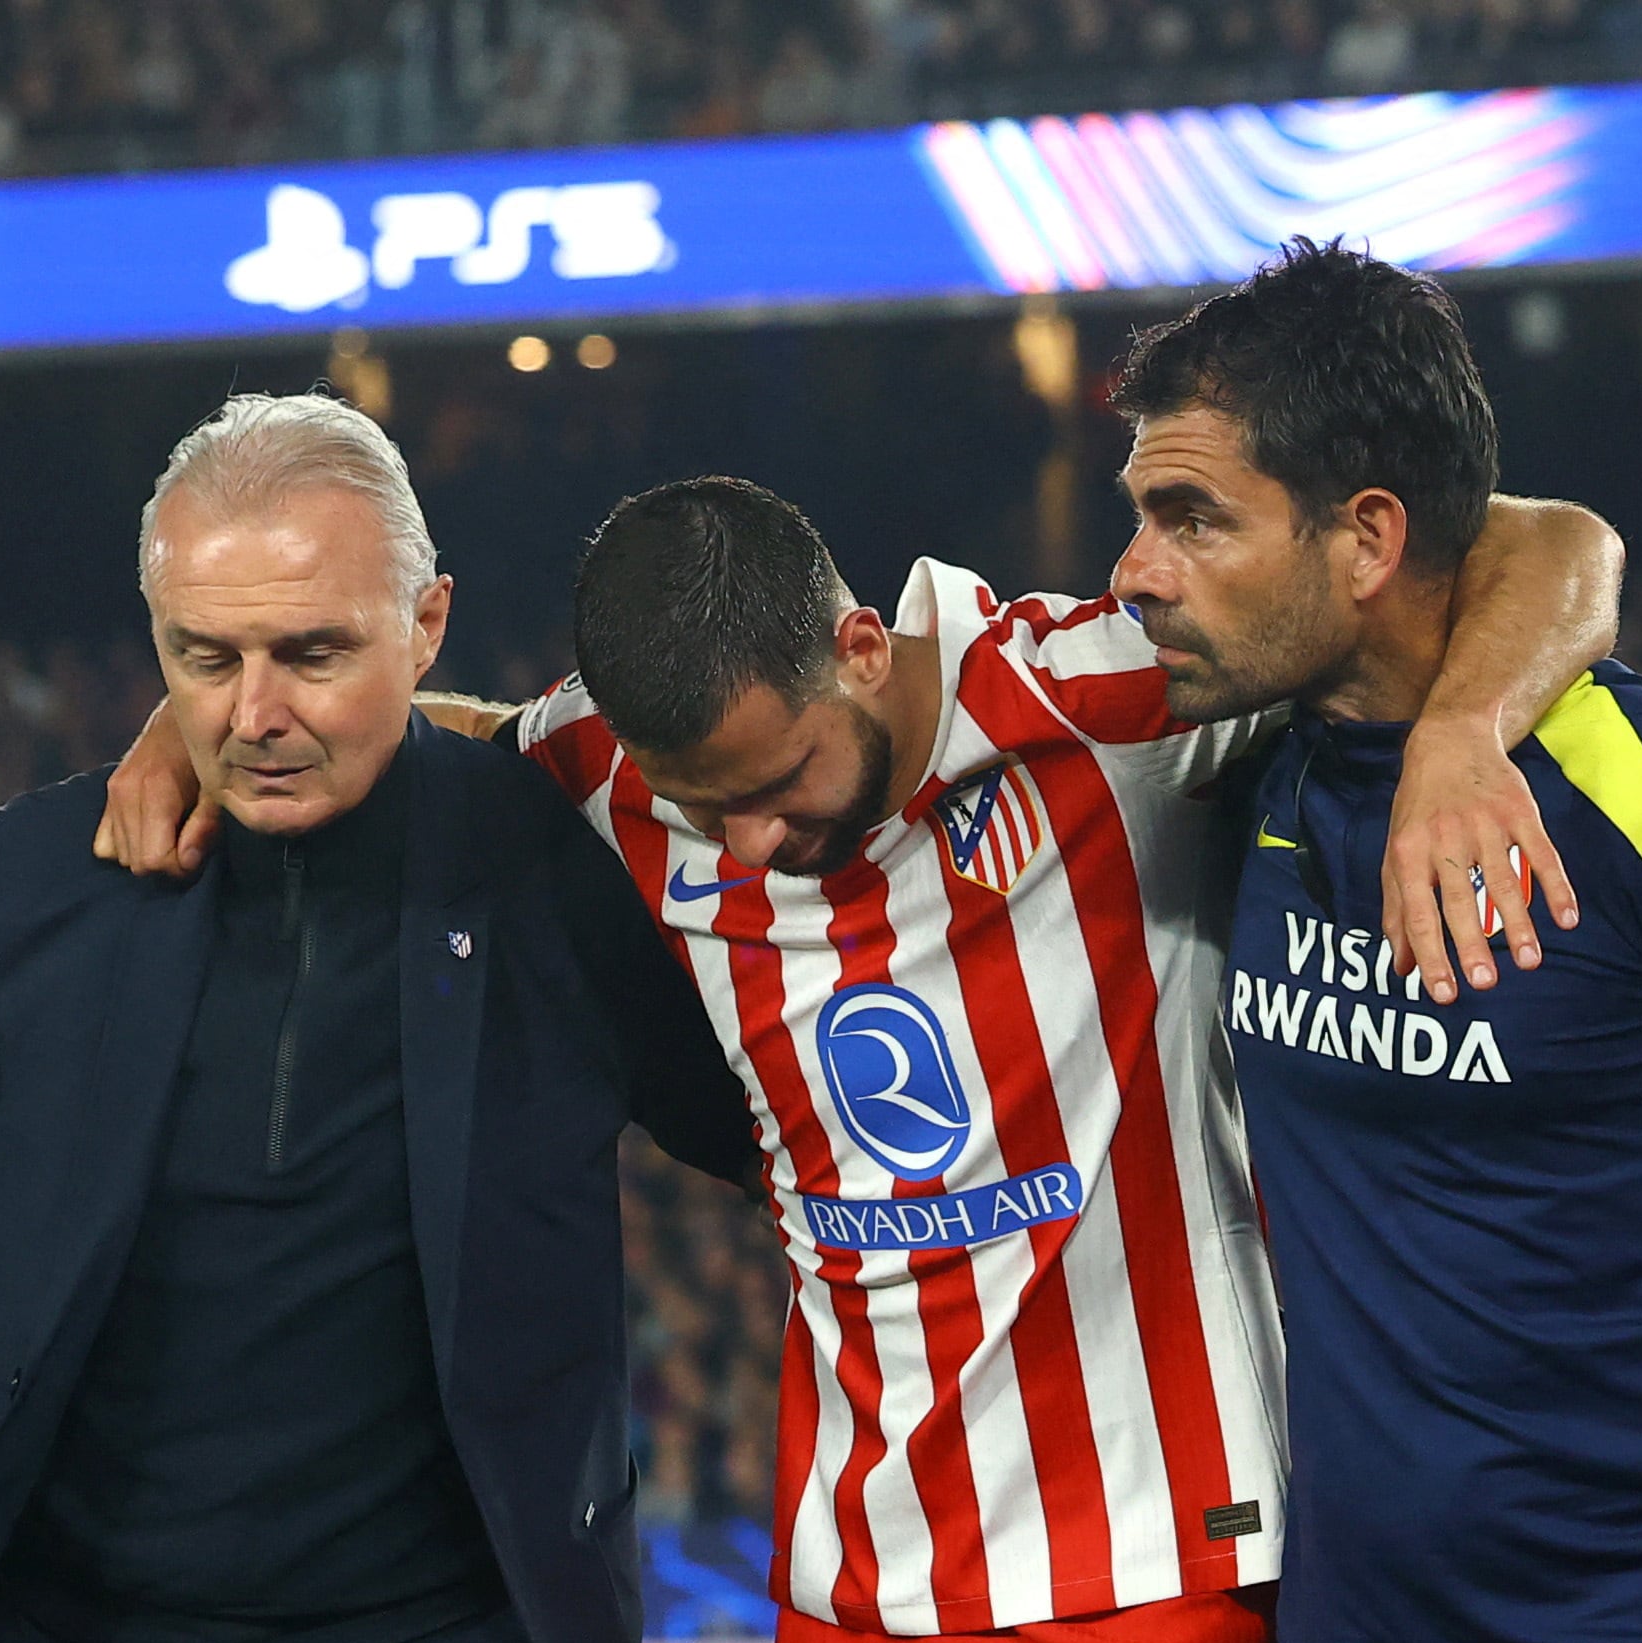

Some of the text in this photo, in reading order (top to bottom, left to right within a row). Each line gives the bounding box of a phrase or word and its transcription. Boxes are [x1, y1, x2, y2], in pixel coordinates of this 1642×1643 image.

[371, 180, 666, 289] PS5
[1231, 969, 1512, 1083] RWANDA
[811, 1172, 1074, 1243] RIYADH AIR
